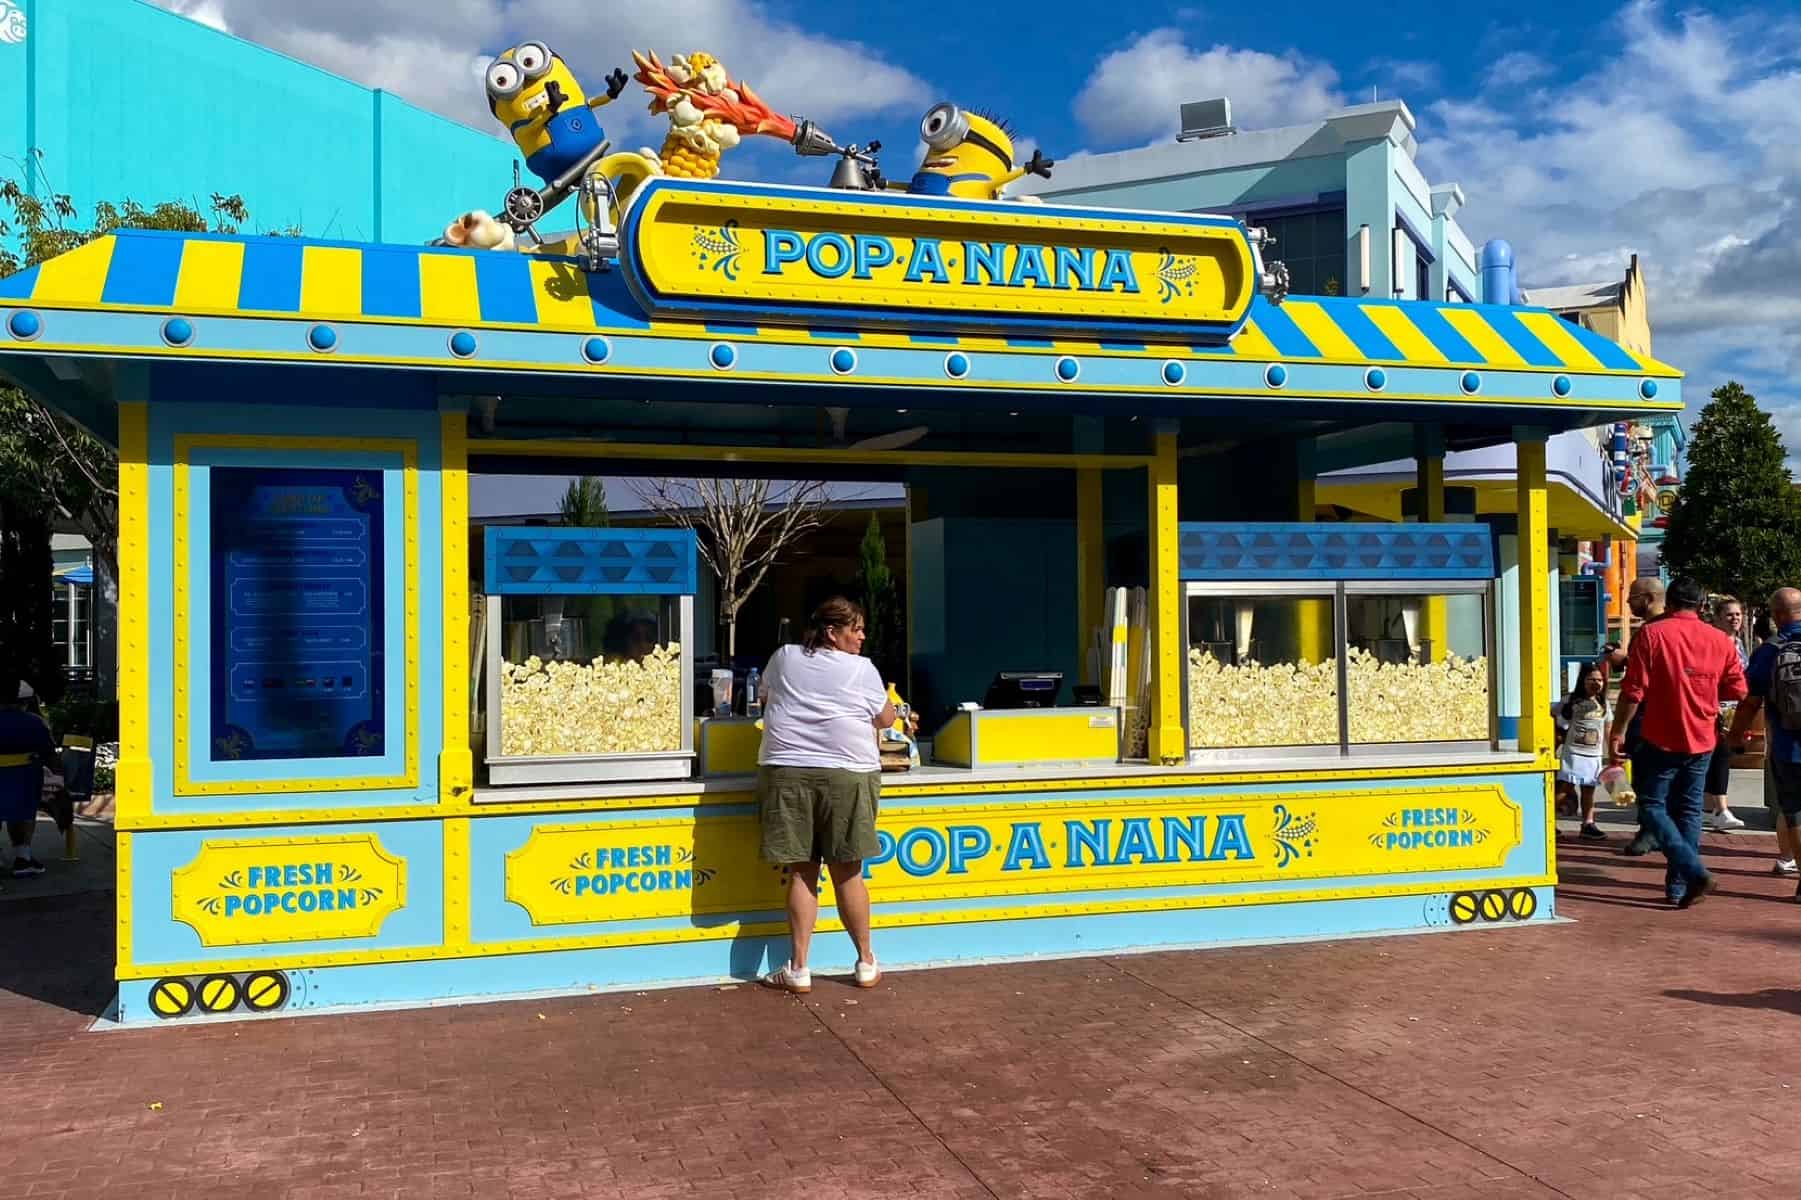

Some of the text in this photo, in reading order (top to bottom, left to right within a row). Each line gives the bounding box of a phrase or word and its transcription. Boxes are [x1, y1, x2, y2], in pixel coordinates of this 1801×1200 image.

[1402, 808, 1458, 827] FRESH
[1386, 830, 1473, 850] POPCORN
[595, 846, 672, 870] FRESH
[248, 863, 333, 888] FRESH
[575, 869, 693, 896] POPCORN
[225, 888, 357, 917] POPCORN
